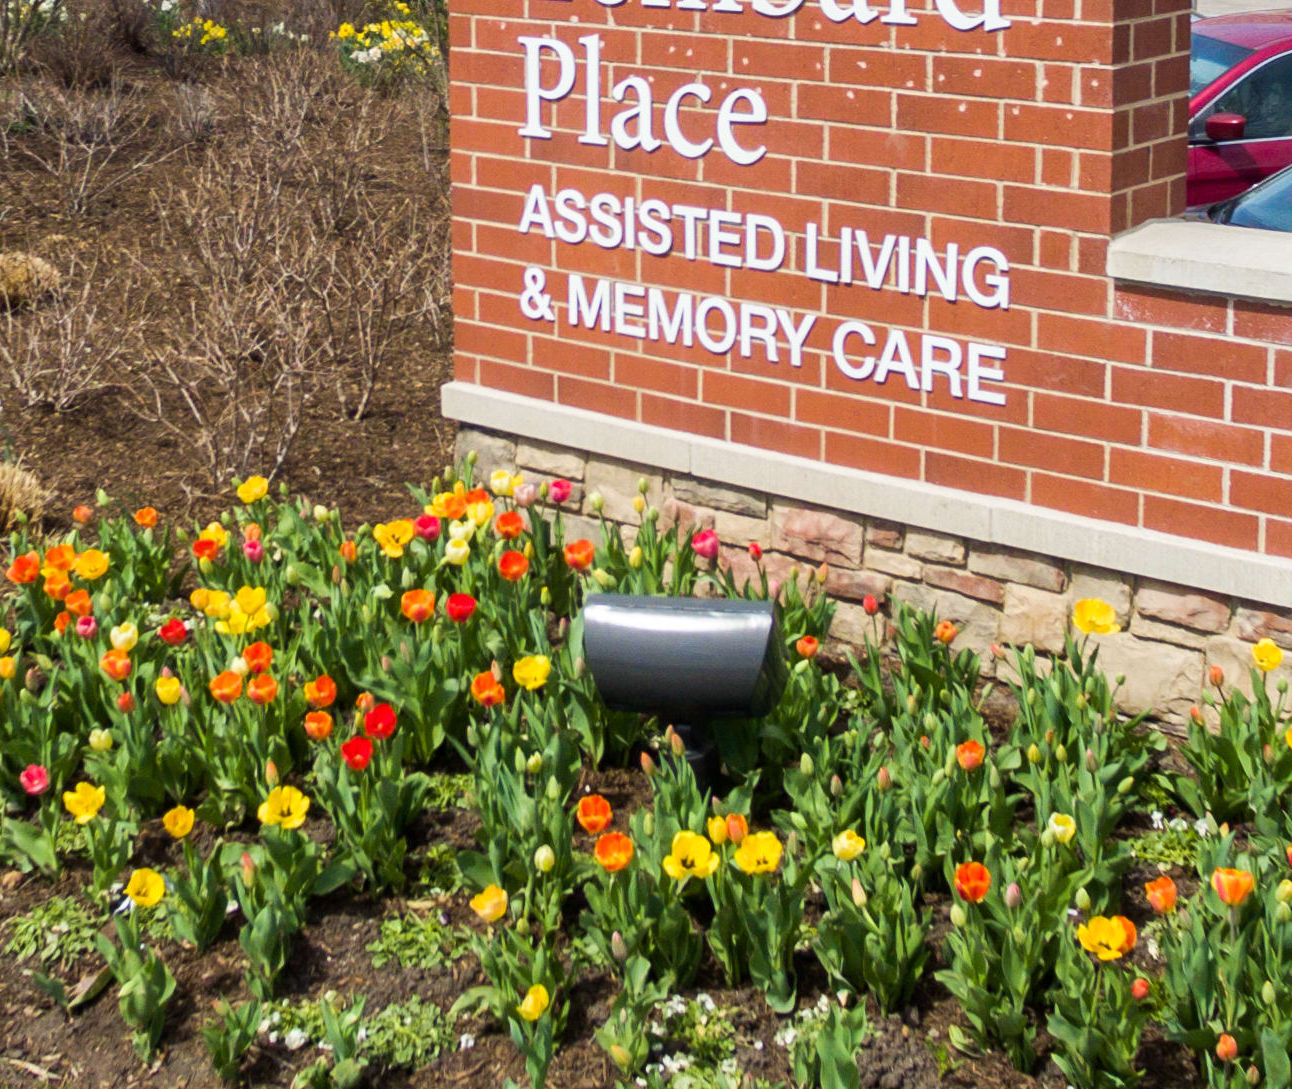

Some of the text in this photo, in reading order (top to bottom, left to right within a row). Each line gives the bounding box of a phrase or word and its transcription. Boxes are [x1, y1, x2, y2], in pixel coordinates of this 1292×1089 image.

[516, 34, 768, 166] Place
[518, 184, 1011, 309] ASSISTED LIVING
[518, 264, 1007, 405] & MEMORY CARE
